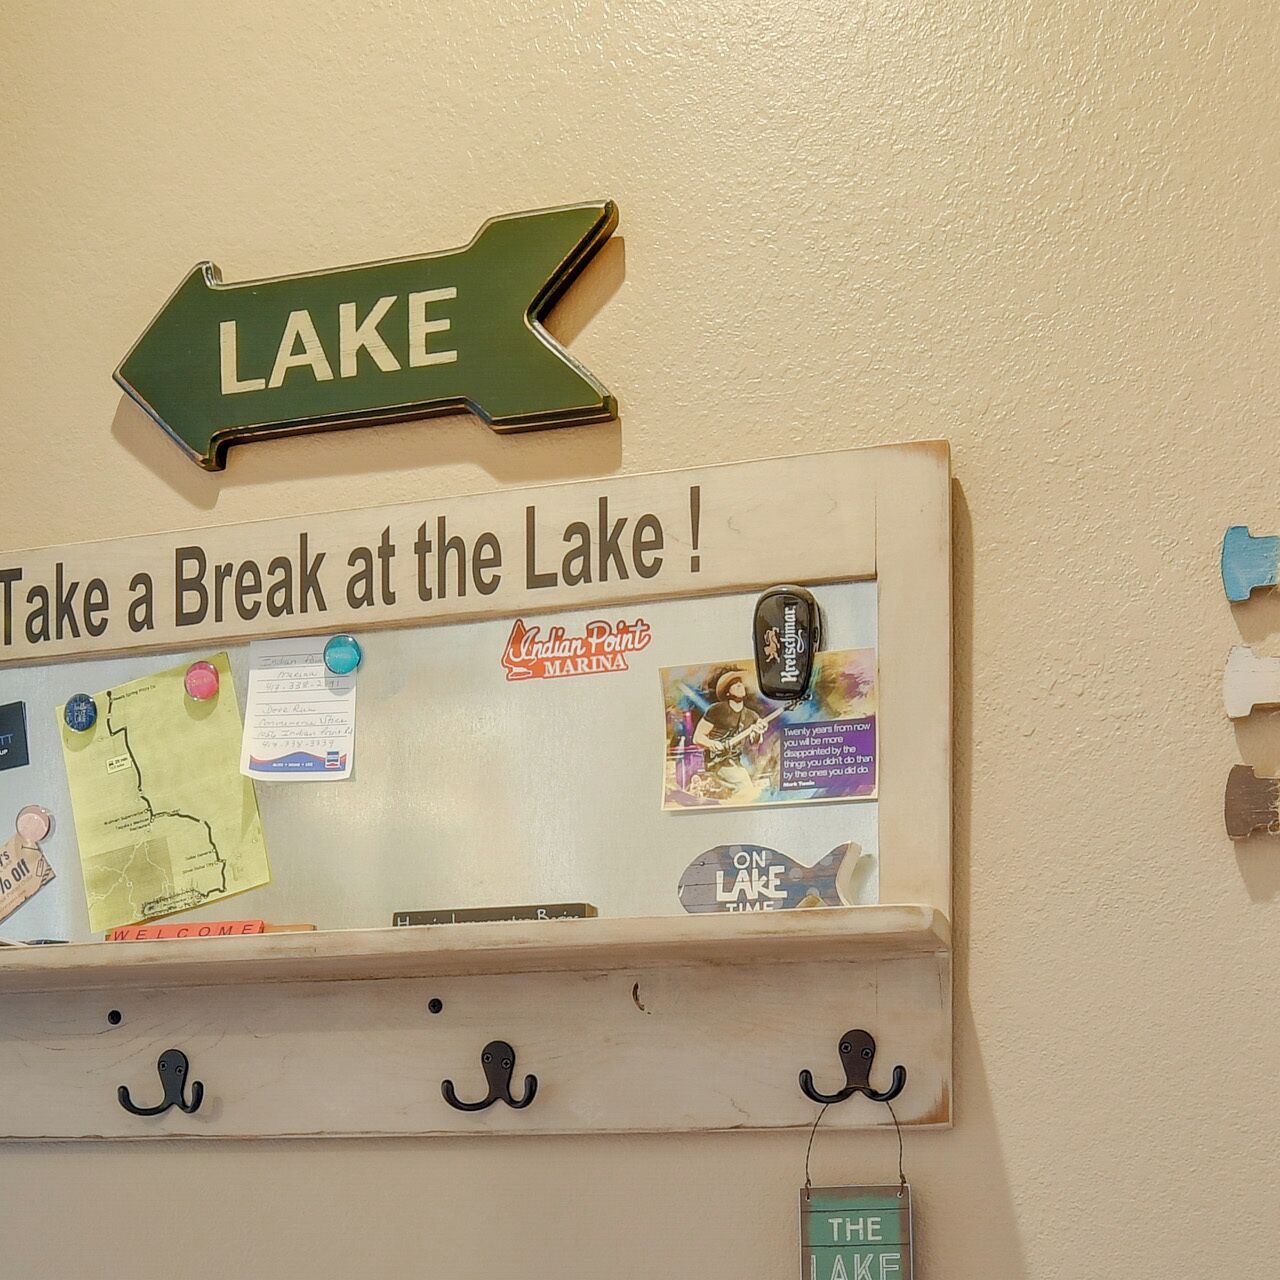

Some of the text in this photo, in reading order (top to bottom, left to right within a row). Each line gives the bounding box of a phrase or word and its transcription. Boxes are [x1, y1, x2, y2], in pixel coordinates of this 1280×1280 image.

[220, 286, 458, 395] LAKE
[127, 573, 155, 633] a
[175, 532, 328, 628] Break
[346, 524, 398, 609] at
[415, 515, 502, 601] the
[525, 496, 664, 590] Lake
[689, 485, 701, 573] !
[509, 619, 650, 662] Indian Point
[780, 605, 805, 684] Kretschmar
[543, 653, 627, 677] MARINA
[784, 727, 811, 737] Twenty
[812, 726, 832, 736] years
[834, 723, 852, 732] from
[784, 736, 843, 750] you will be more
[784, 745, 856, 758] disappointed by the
[784, 760, 806, 769] things
[807, 759, 821, 768] you
[823, 757, 842, 765] didn't
[784, 771, 793, 780] by
[795, 770, 807, 778] the
[809, 769, 827, 777] ones
[829, 768, 843, 777] you
[844, 766, 856, 774] did
[11, 858, 31, 882] Off
[733, 851, 766, 869] ON
[716, 865, 788, 902] LAKE
[114, 924, 254, 941] WELCOME
[828, 1217, 883, 1242] THE
